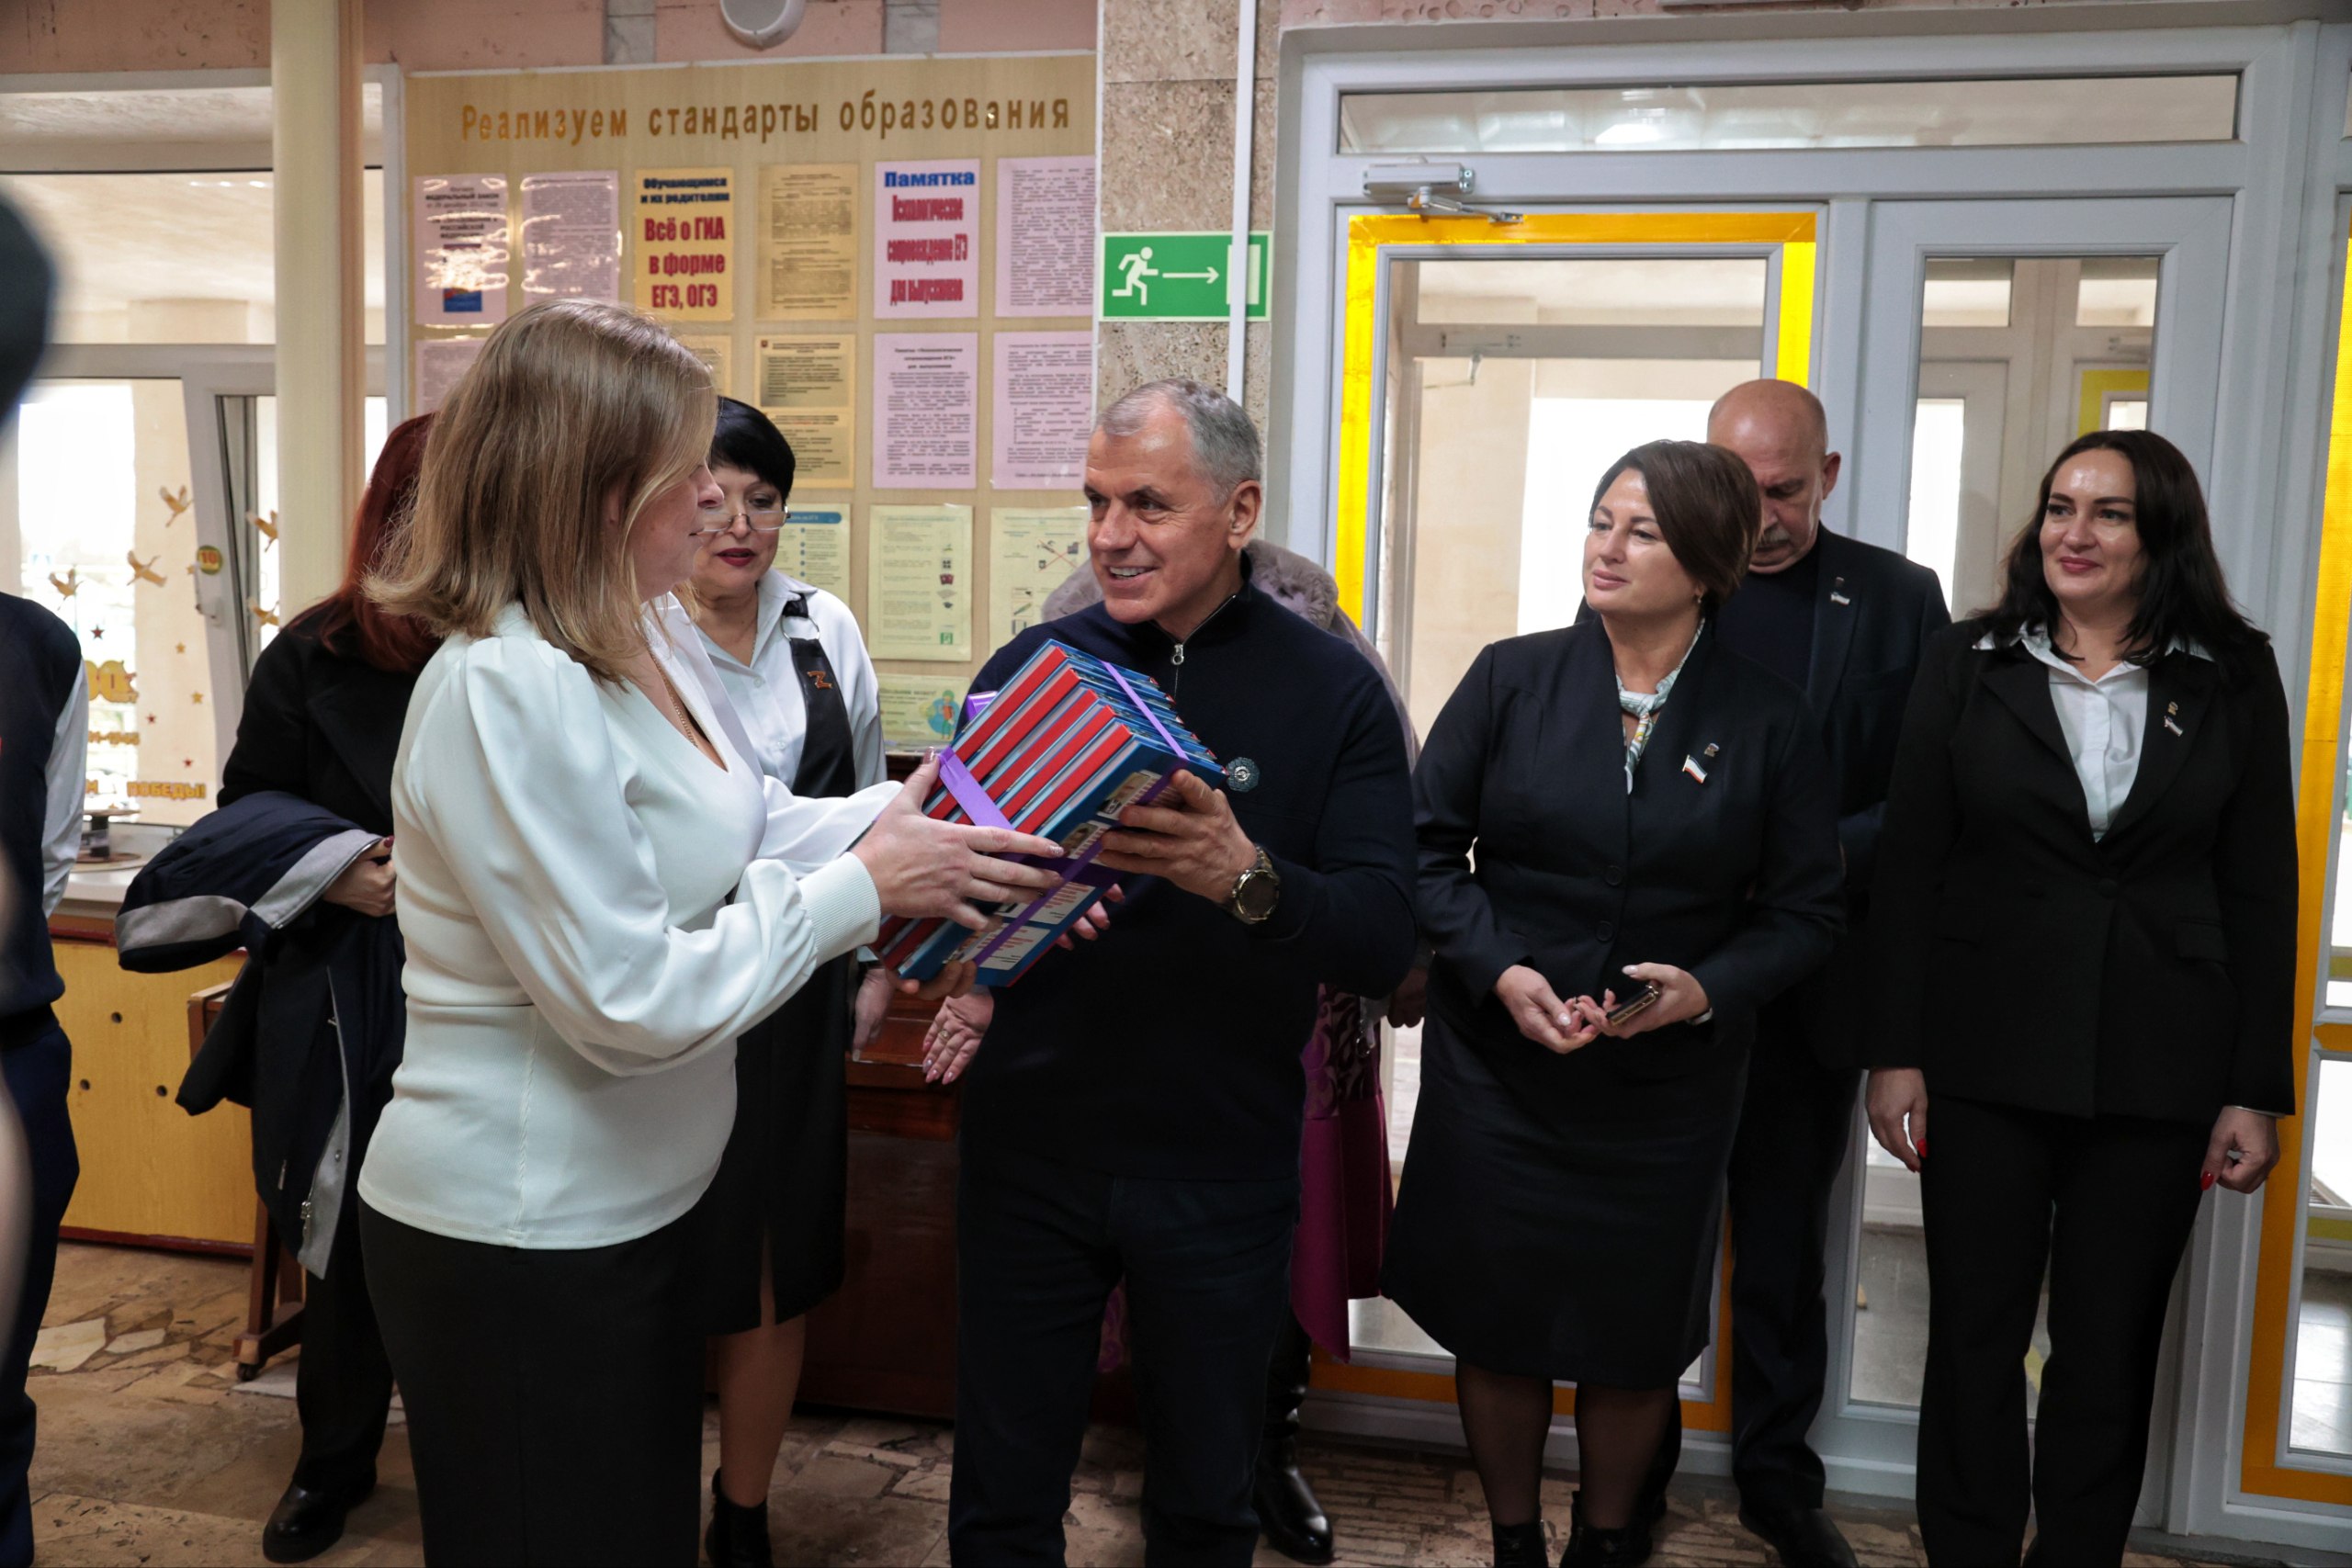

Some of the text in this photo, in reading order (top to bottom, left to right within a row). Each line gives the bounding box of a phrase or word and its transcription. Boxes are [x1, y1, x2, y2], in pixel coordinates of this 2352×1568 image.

[462, 89, 1069, 146] Реализуем стандарты образования
[884, 171, 975, 187] Памятка
[645, 216, 726, 242] Всё о ГИА
[649, 252, 726, 276] в форме
[651, 283, 718, 310] ЕГЭ, ОГЭ
